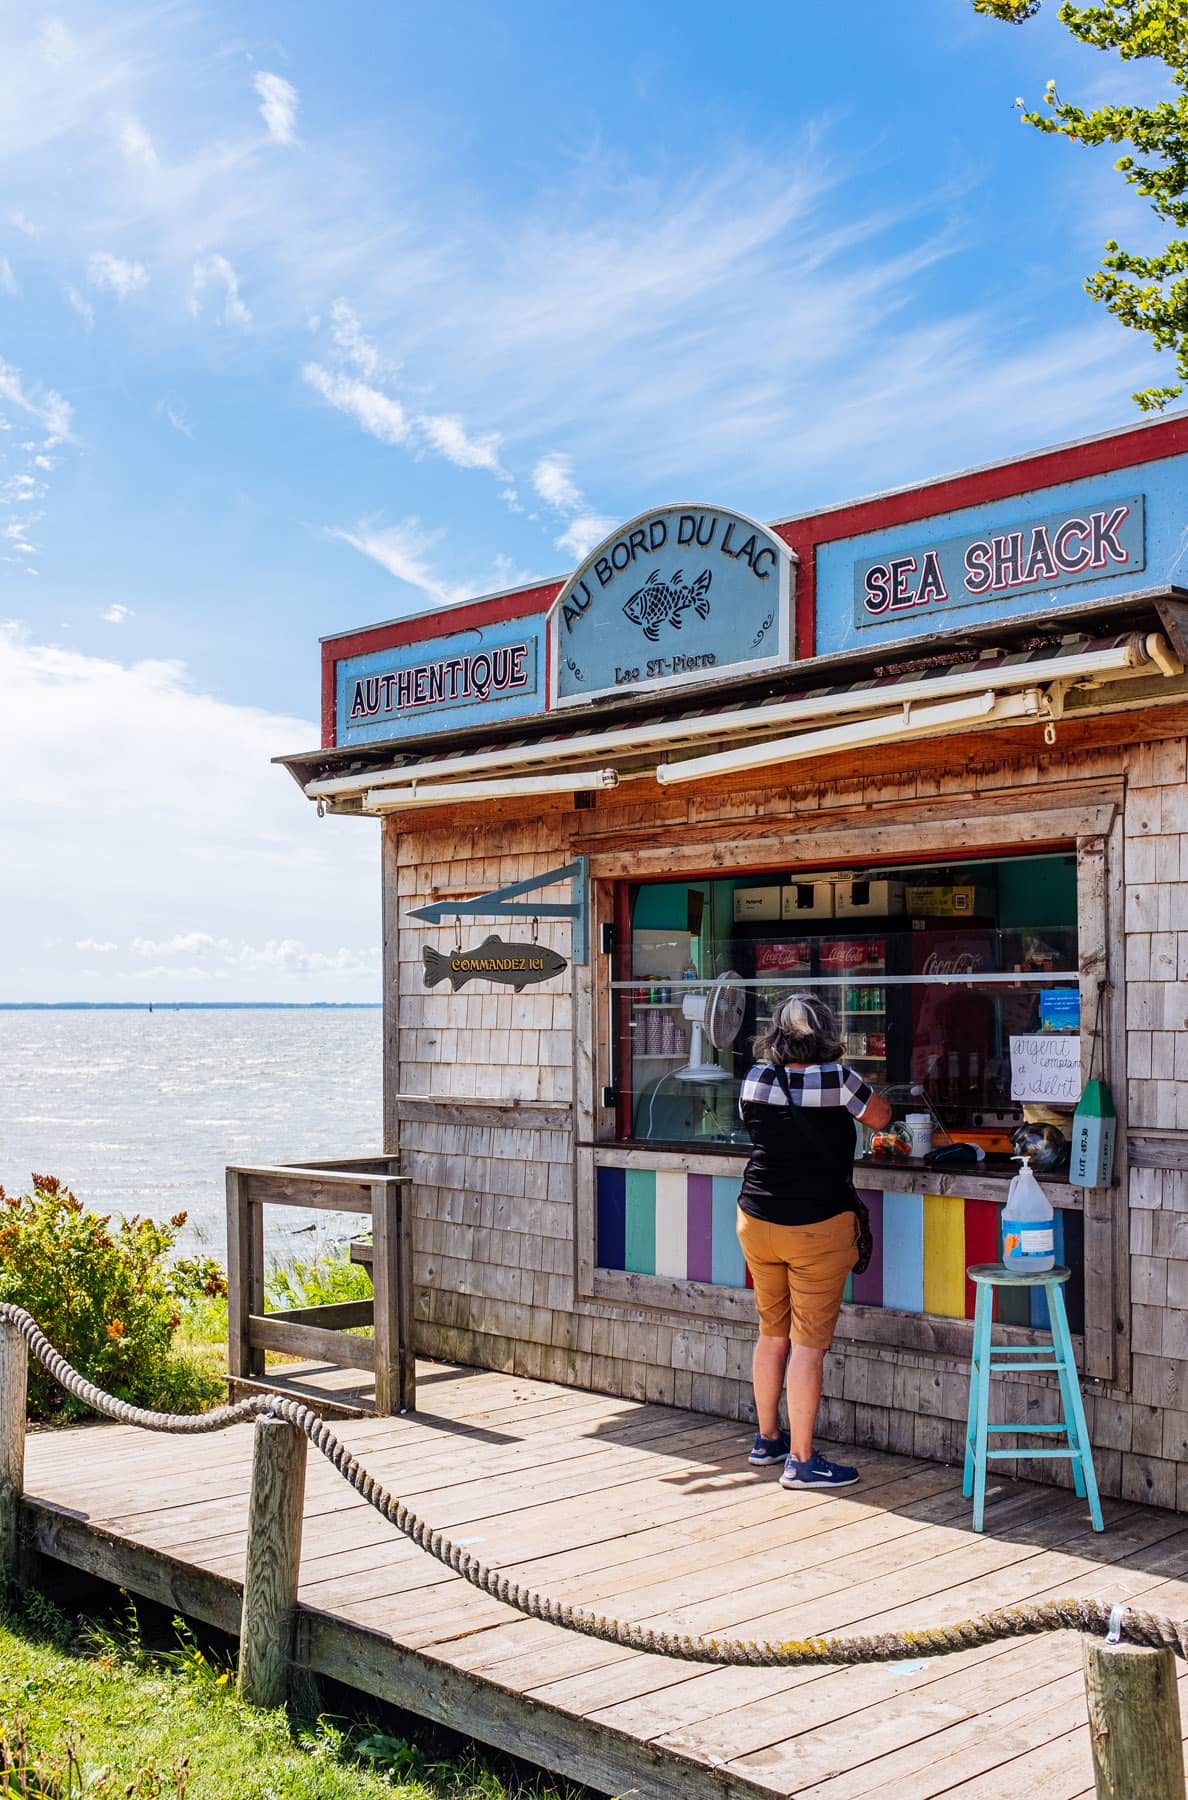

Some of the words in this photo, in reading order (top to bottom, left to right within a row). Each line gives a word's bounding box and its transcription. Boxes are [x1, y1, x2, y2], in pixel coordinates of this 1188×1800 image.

[562, 580, 592, 634] AU
[593, 519, 668, 587] BORD
[677, 515, 717, 546] DU
[720, 522, 777, 579] LAC
[864, 551, 948, 615] SEA
[963, 506, 1130, 595] SHACK
[350, 644, 528, 719] AUTHENTIQUE
[615, 666, 640, 684] Lac
[646, 652, 716, 678] ST-Pierre
[451, 959, 526, 972] COMMANDEZ
[529, 958, 544, 971] ICI
[1013, 1038, 1070, 1065] argent
[1040, 1058, 1081, 1069] comptan
